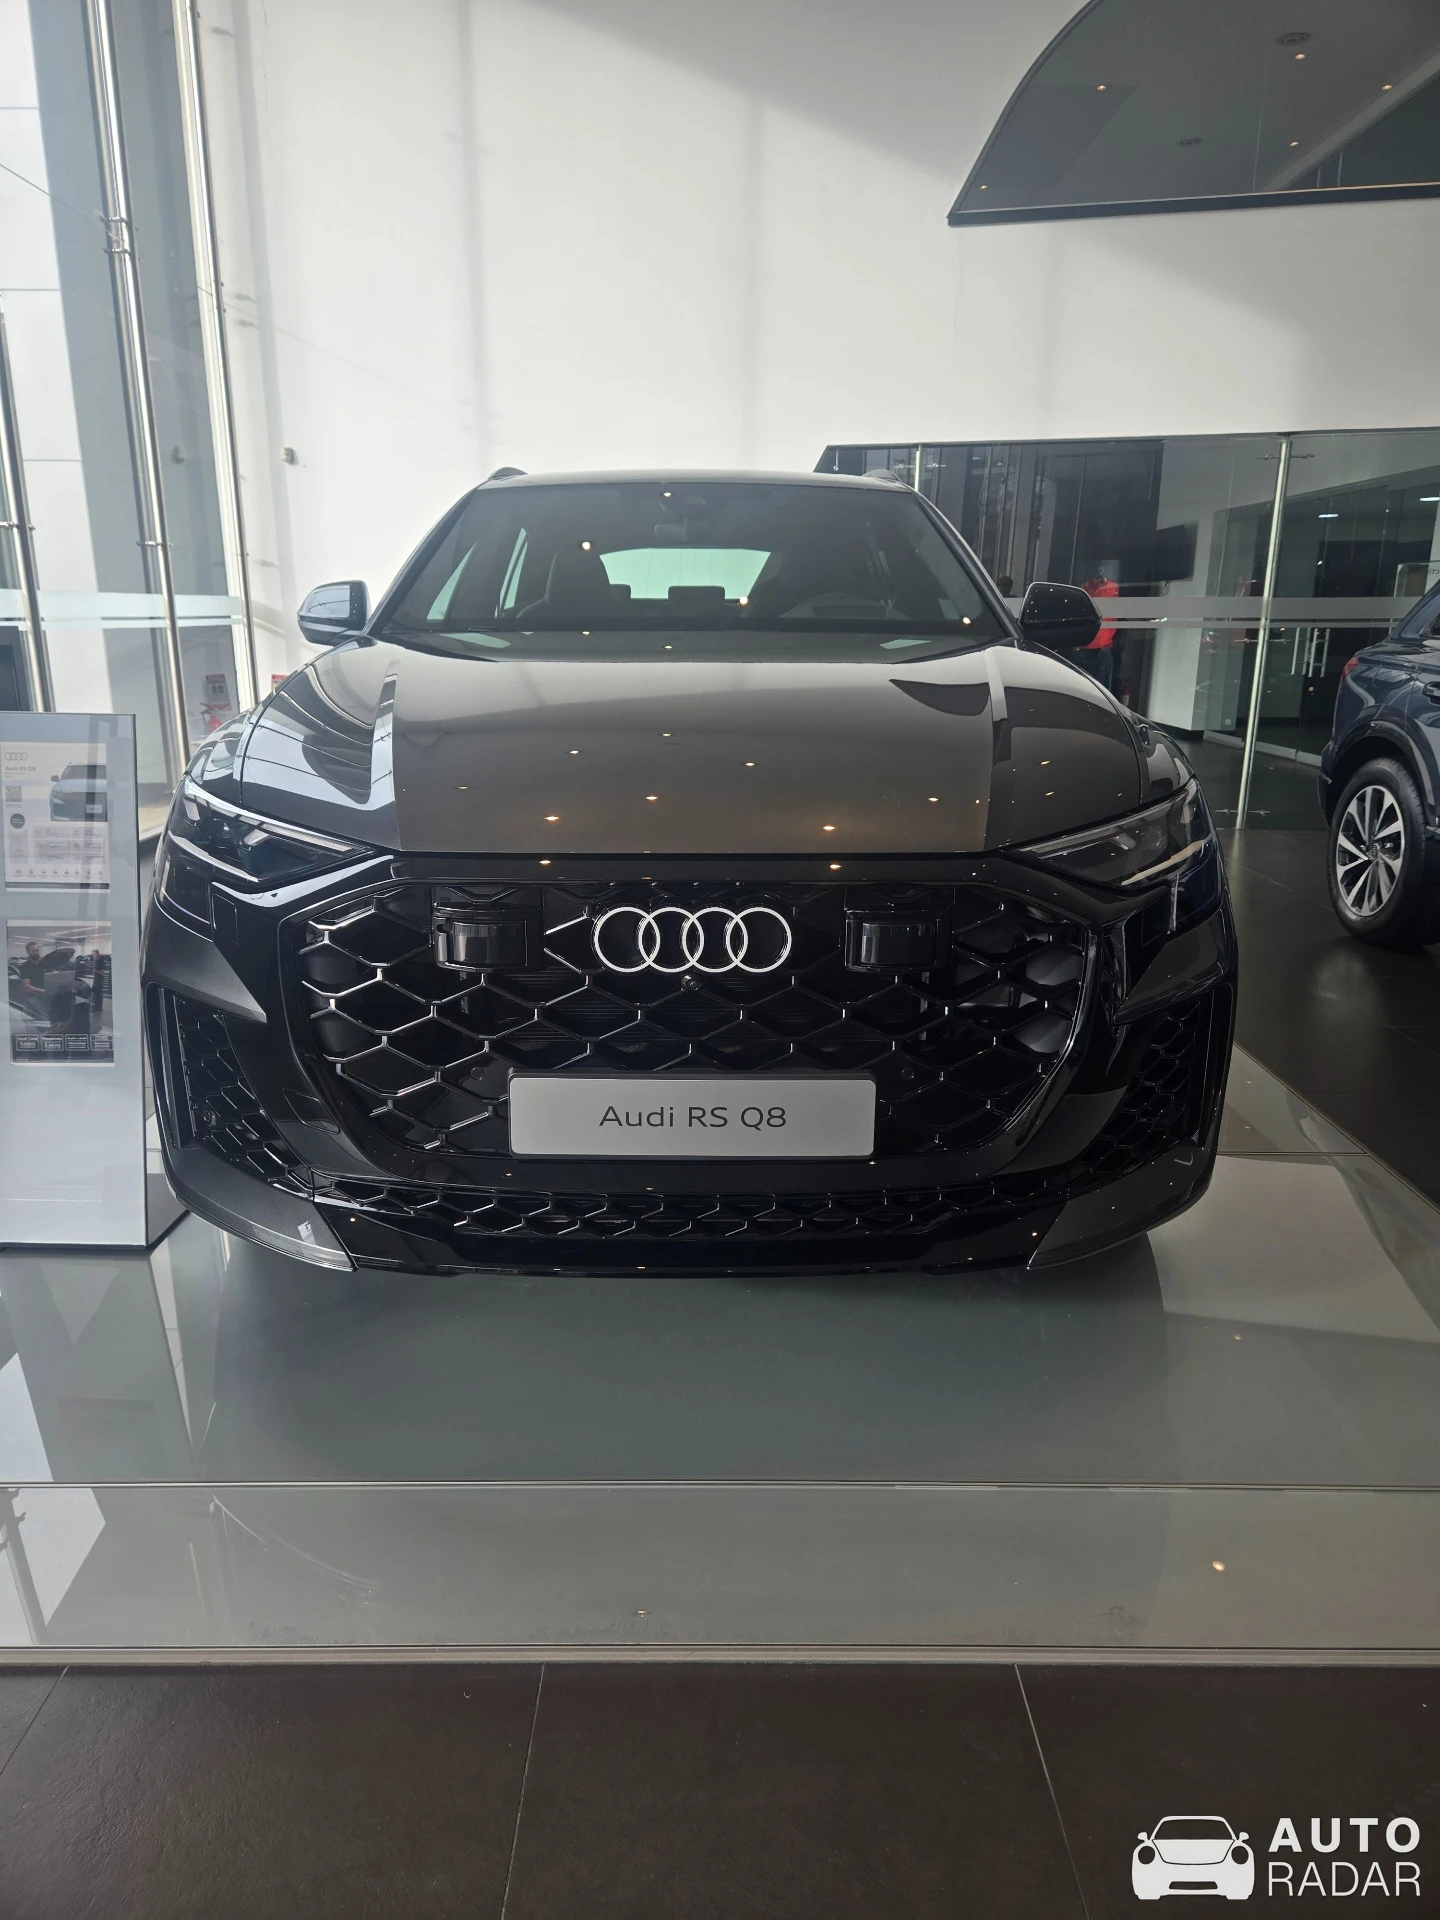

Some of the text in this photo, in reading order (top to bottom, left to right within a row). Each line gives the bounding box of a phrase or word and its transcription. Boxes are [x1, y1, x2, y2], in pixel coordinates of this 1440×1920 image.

[599, 1105, 787, 1131] Audi RS Q8
